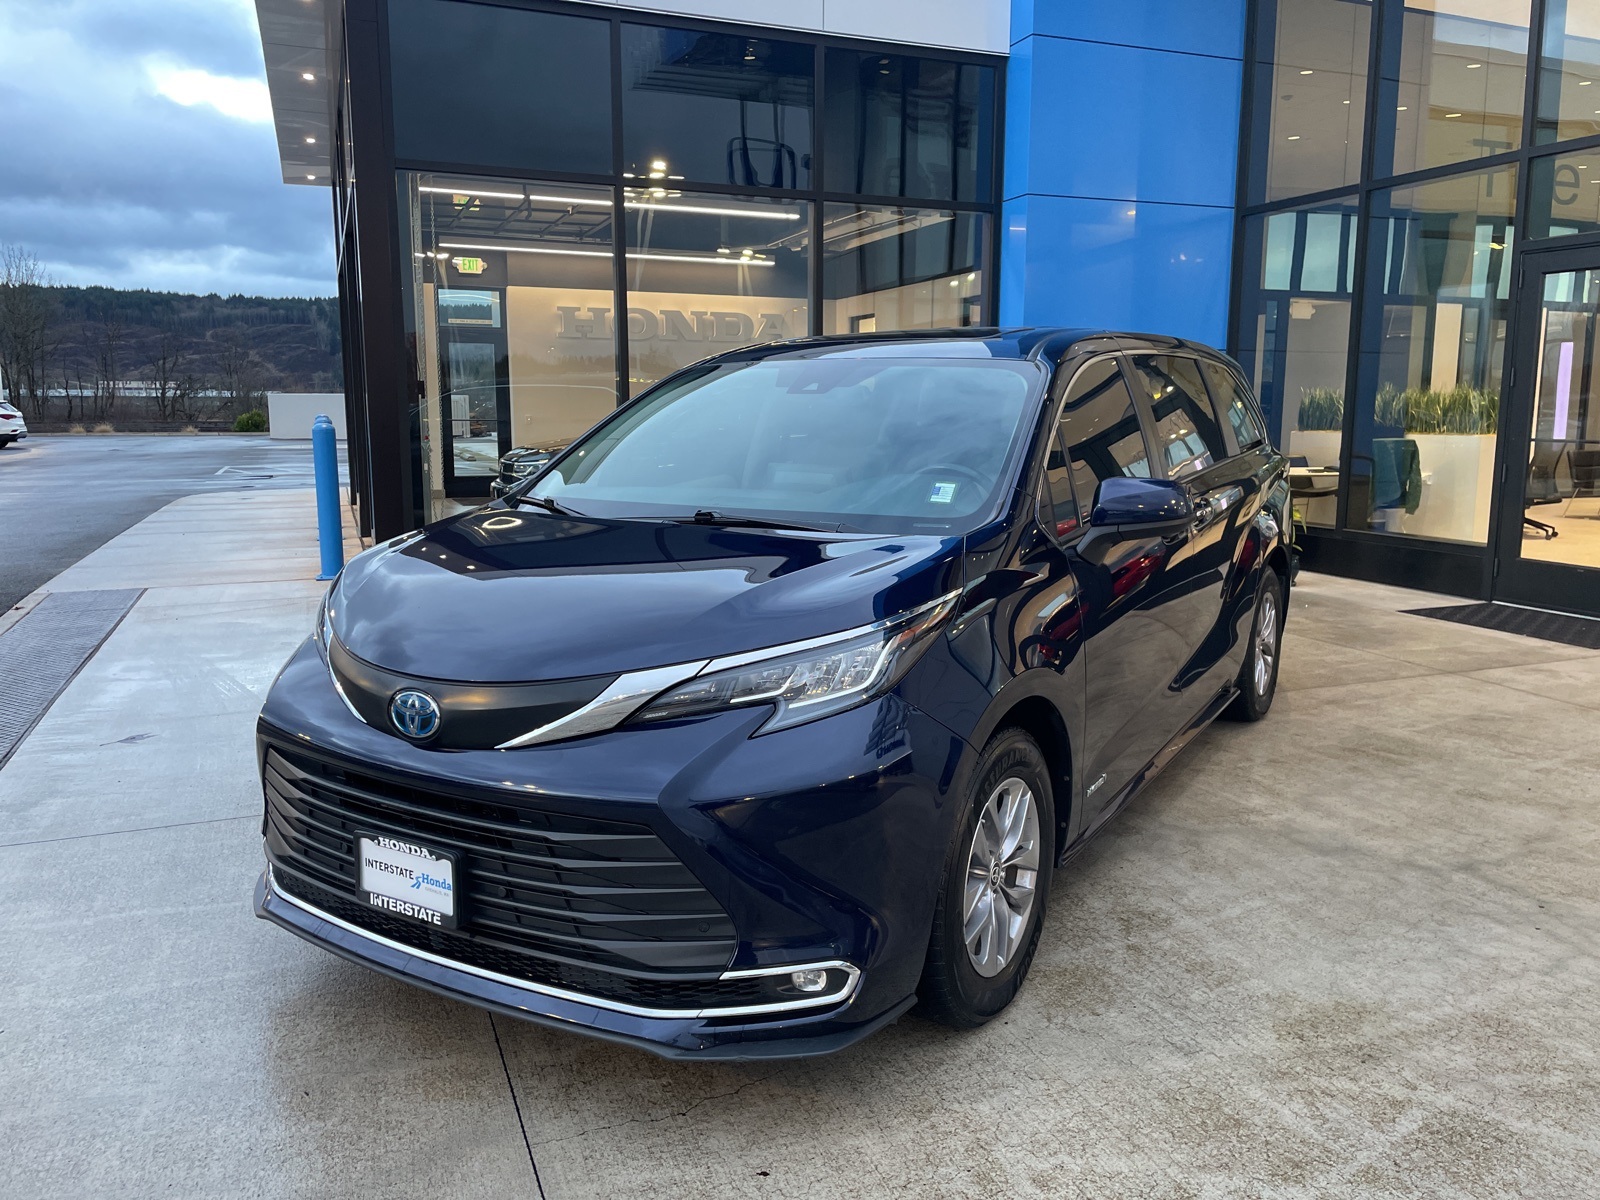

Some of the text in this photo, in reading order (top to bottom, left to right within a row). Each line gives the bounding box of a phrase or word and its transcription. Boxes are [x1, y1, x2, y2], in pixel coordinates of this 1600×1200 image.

[462, 258, 479, 272] EXIT
[556, 306, 787, 341] HONDA
[378, 836, 432, 860] HONDA
[365, 857, 452, 891] INTERSTATE Honda
[370, 892, 442, 925] INTERSTATE
